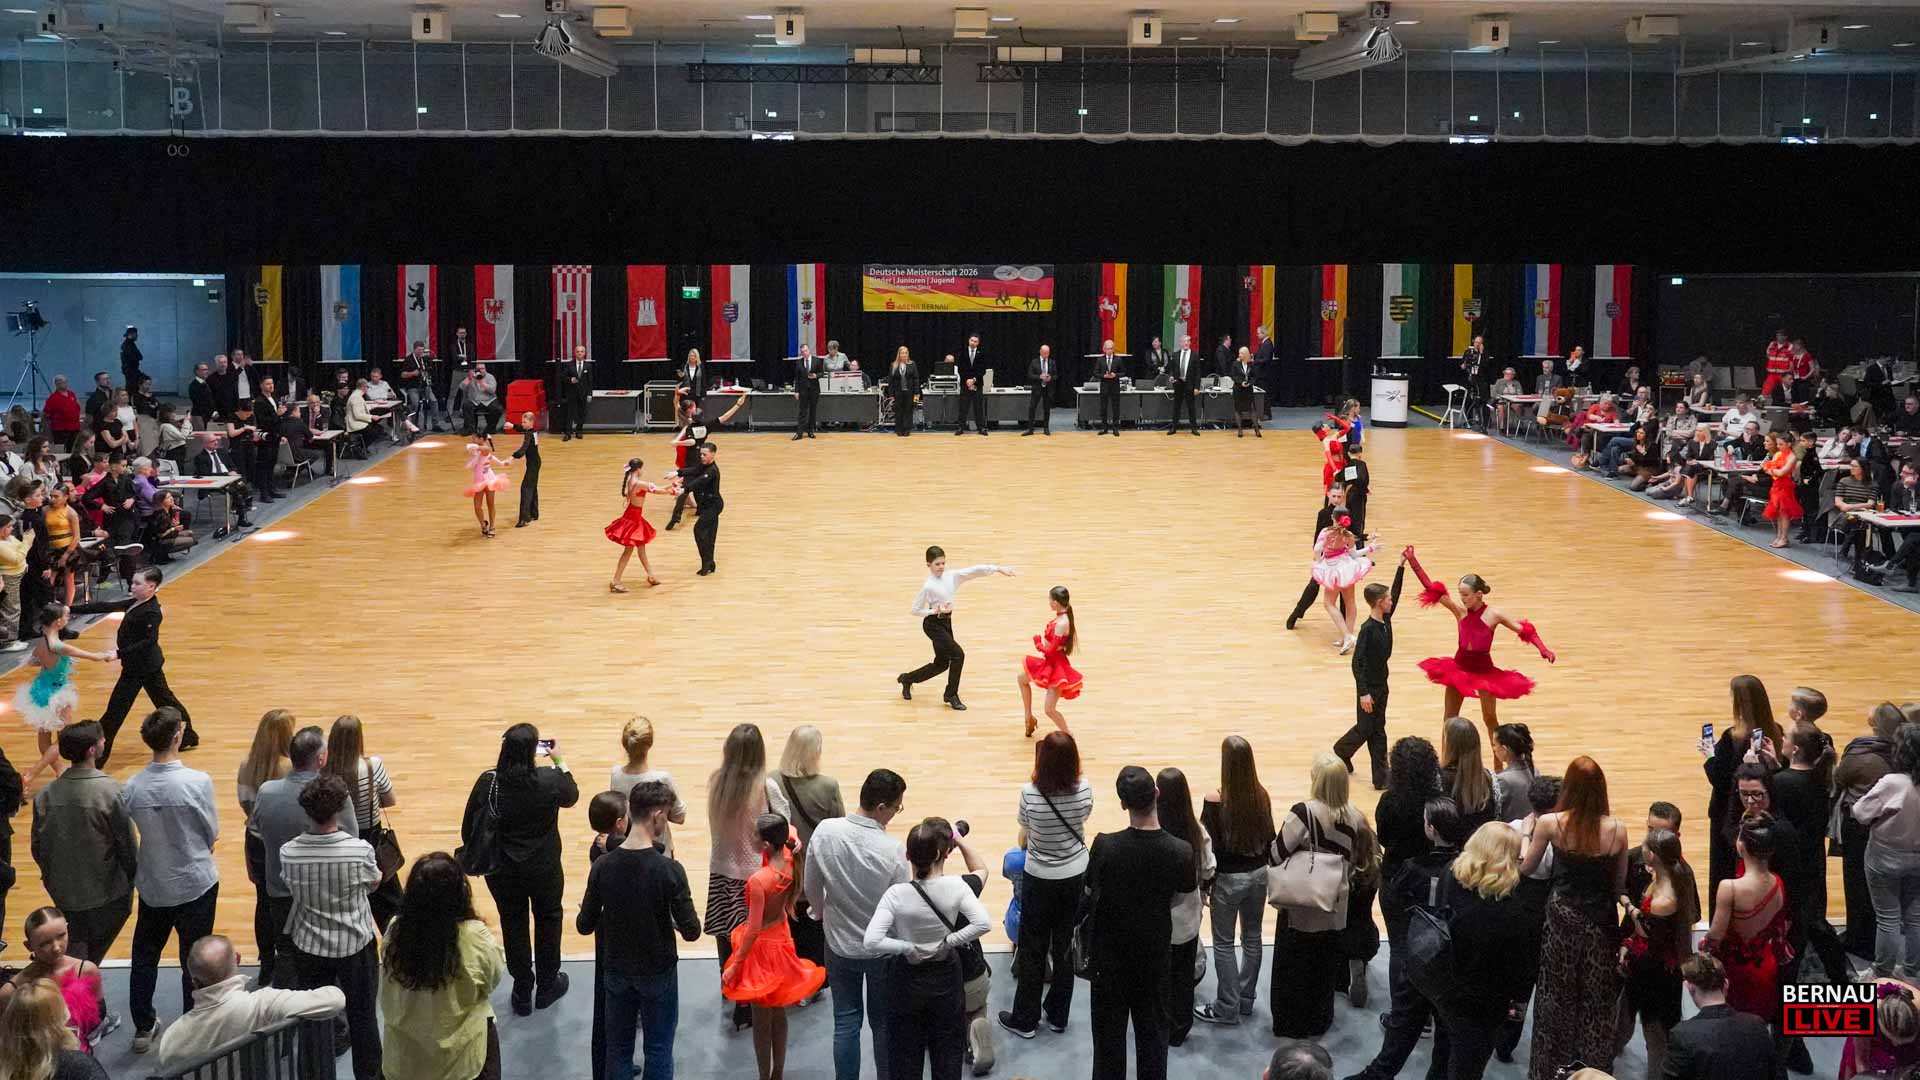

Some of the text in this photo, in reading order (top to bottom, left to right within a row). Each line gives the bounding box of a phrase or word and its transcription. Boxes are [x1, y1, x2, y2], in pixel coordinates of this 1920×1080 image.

[173, 87, 194, 115] B
[869, 268, 978, 276] Deutsche Meisterschaft 2026
[930, 277, 955, 285] Jugend
